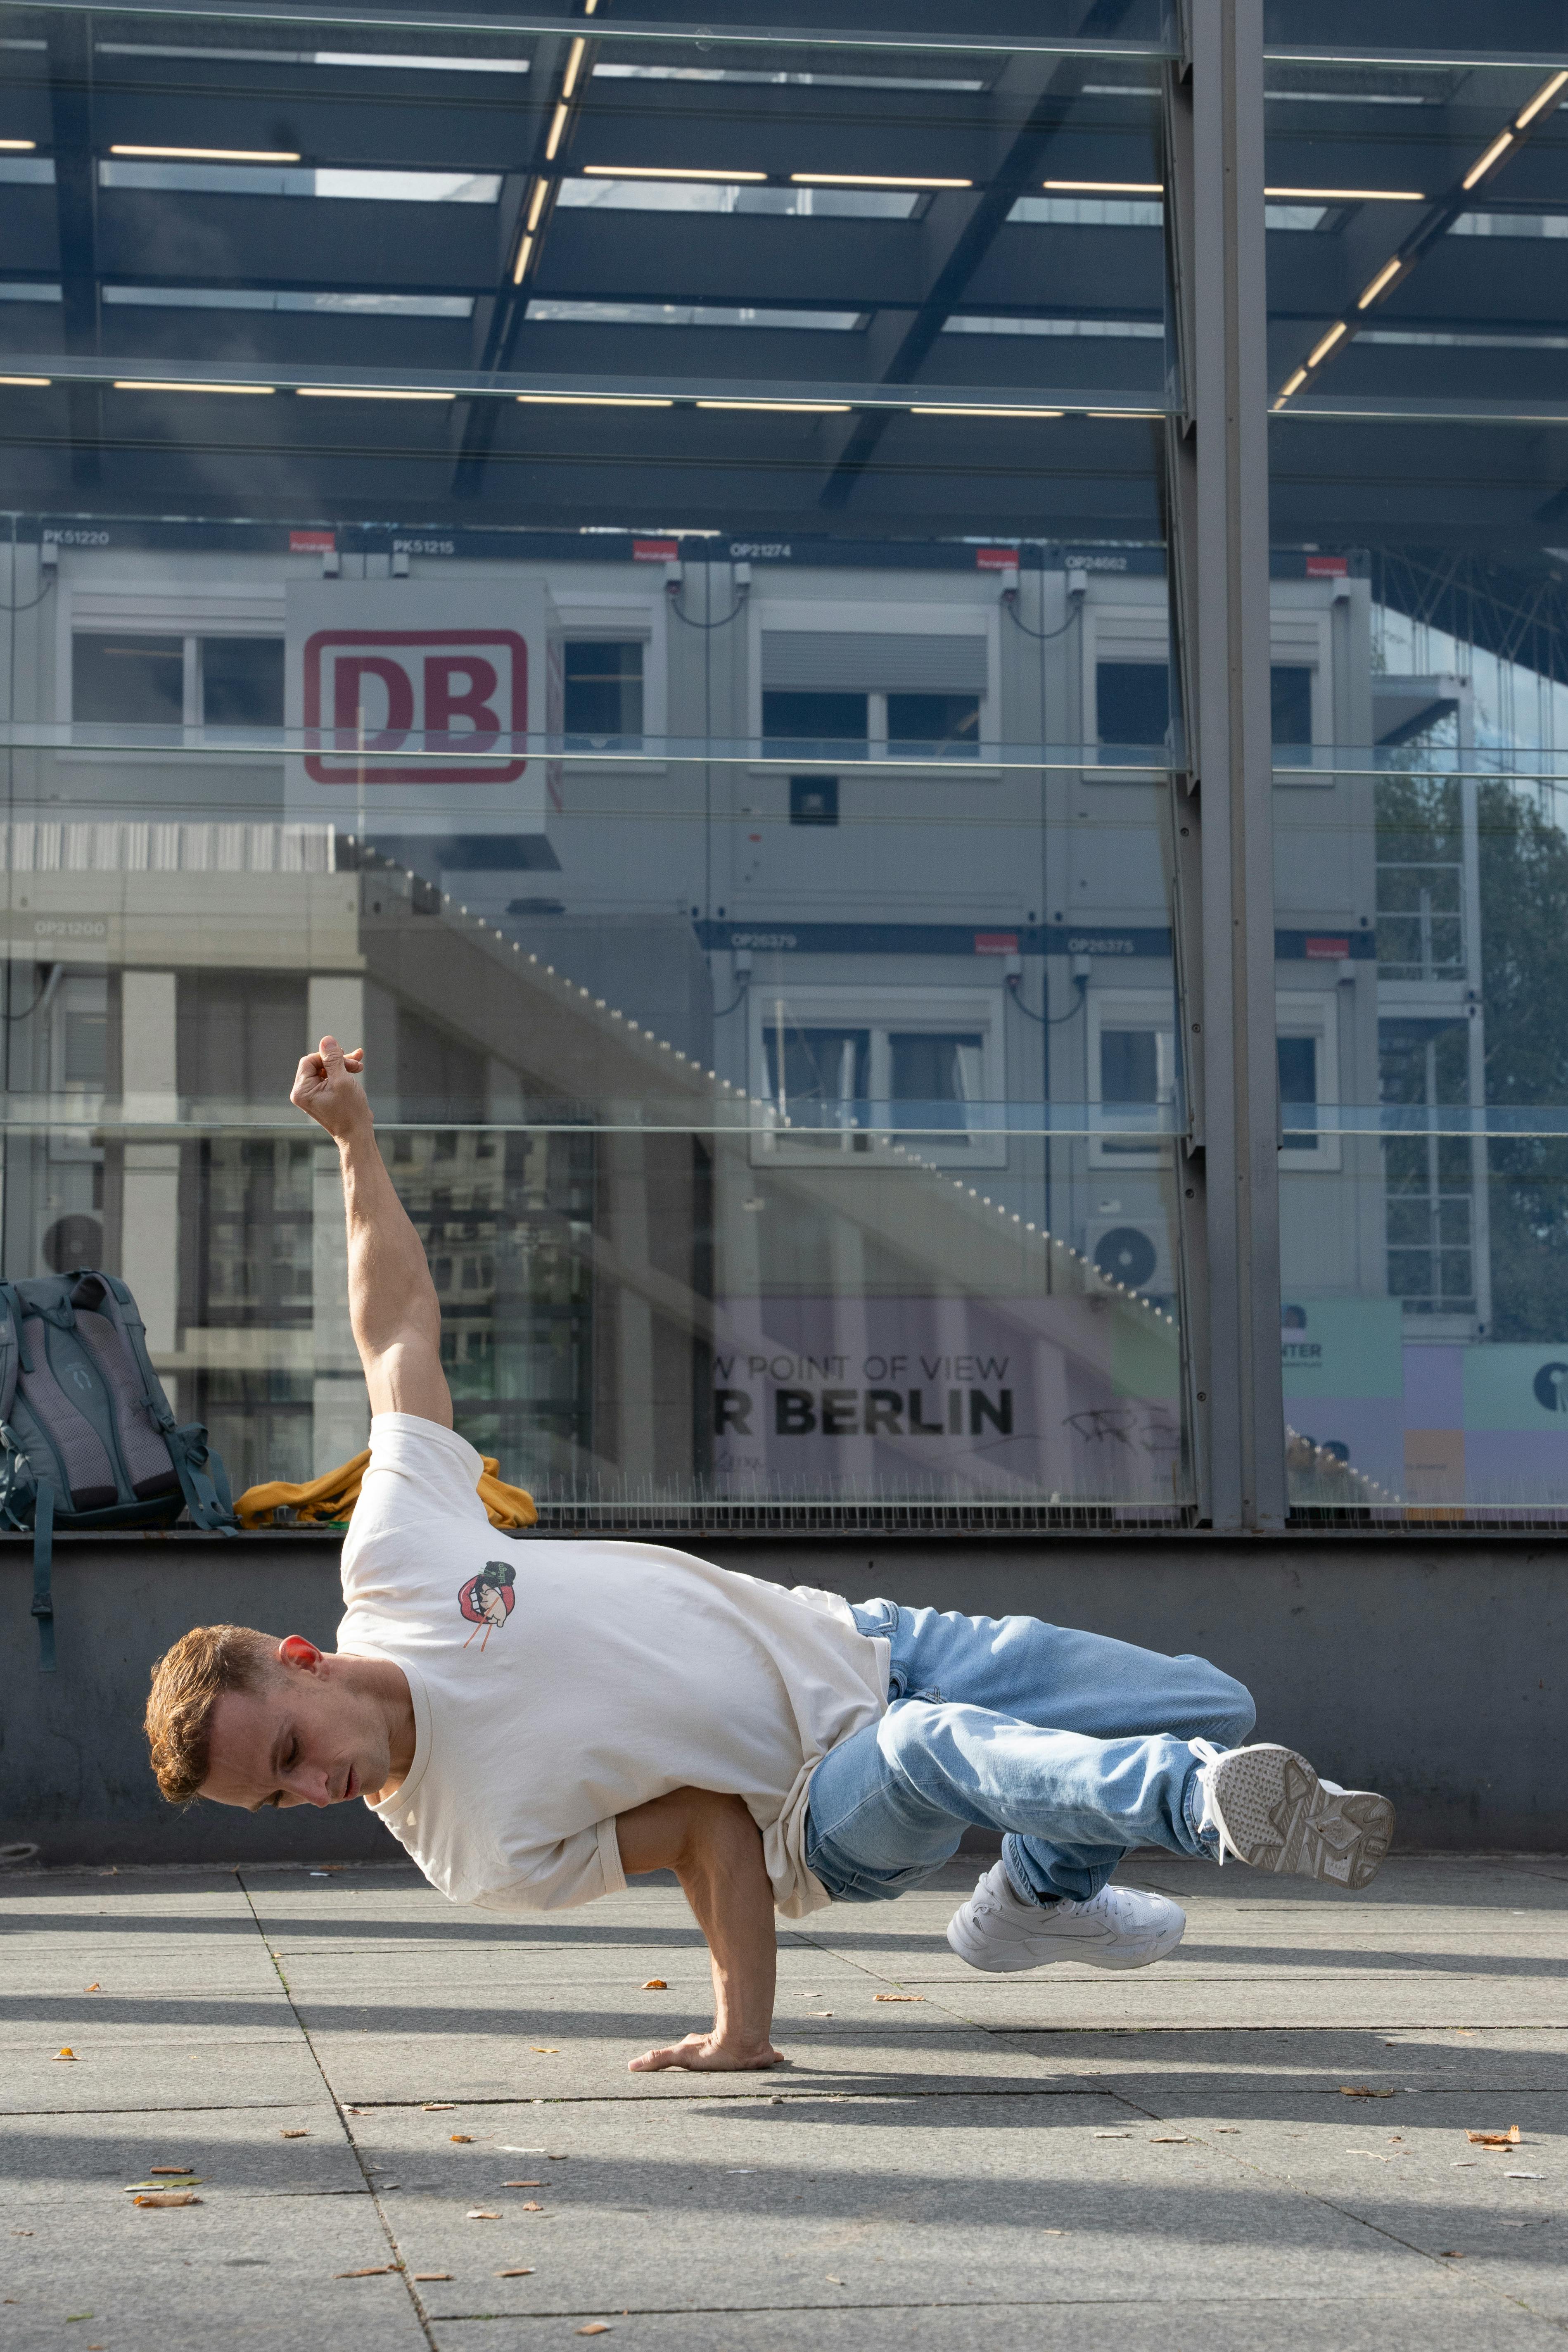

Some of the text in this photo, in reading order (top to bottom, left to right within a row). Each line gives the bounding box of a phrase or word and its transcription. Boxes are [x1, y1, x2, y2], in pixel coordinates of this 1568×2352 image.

[334, 656, 501, 758] DB
[748, 1355, 848, 1381] POINT
[863, 1355, 908, 1381] OF
[919, 1355, 1009, 1381] VIEW
[776, 1388, 1013, 1436] BERLIN
[498, 1563, 507, 1584] bibigo
